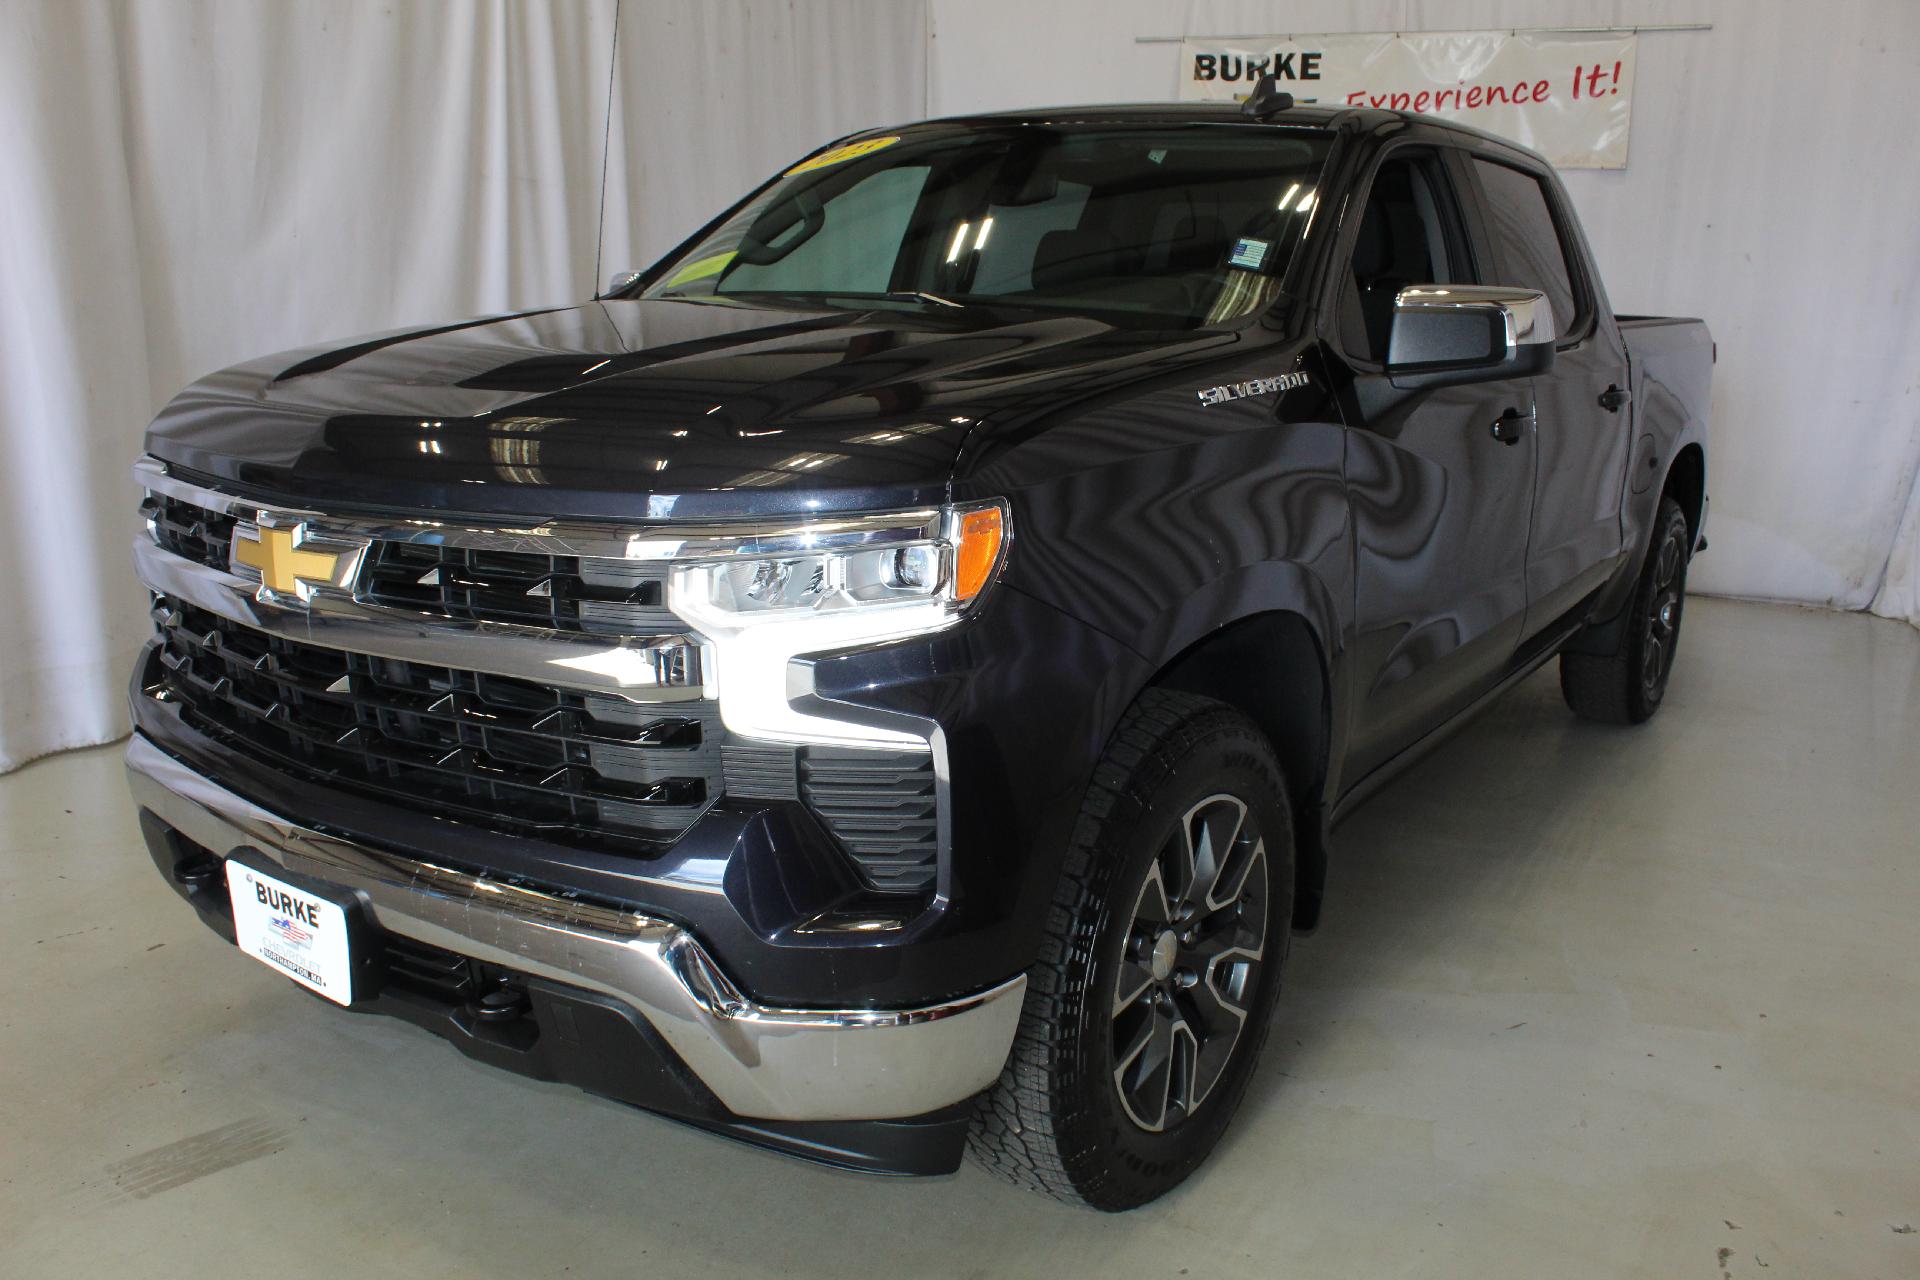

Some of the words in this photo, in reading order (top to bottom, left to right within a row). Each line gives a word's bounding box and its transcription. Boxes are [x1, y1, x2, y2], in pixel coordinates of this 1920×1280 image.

[1193, 52, 1322, 82] BURKE
[1572, 61, 1622, 99] It!
[256, 881, 319, 928] BURKE
[262, 936, 321, 974] CHEVROLET
